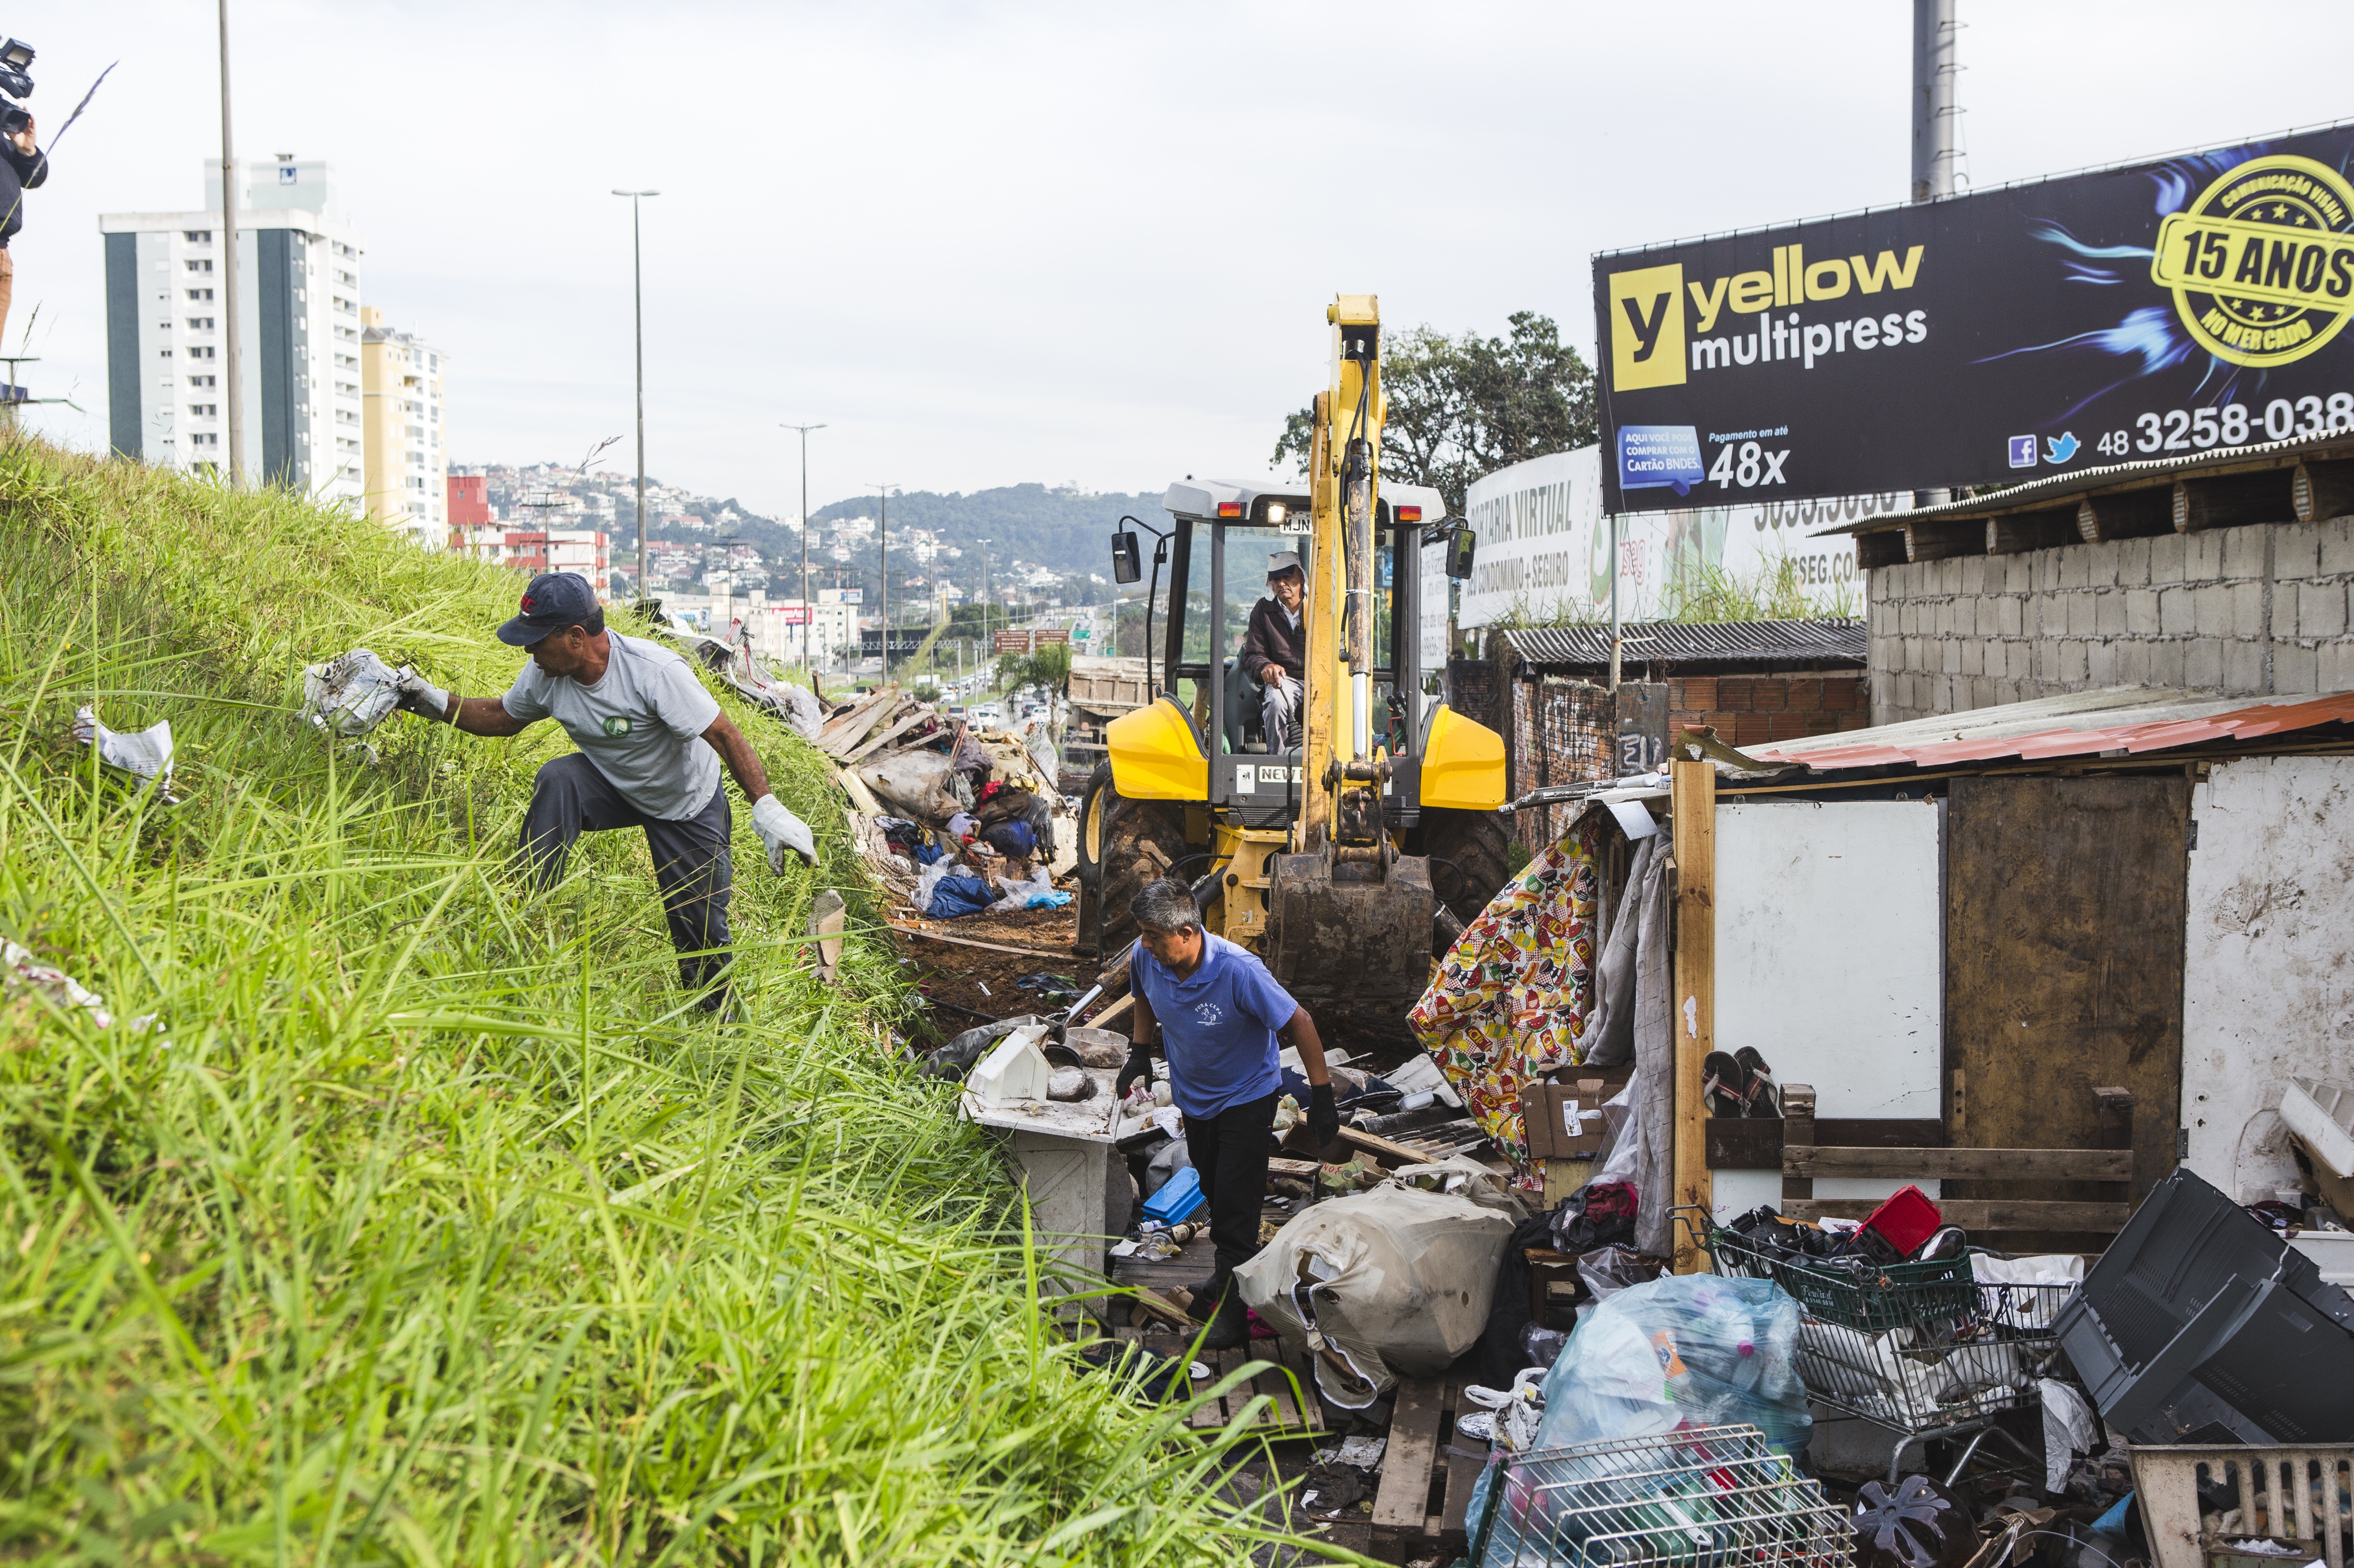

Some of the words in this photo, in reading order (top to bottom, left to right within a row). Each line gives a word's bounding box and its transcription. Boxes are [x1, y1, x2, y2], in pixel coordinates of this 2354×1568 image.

[2221, 174, 2313, 209] COMUNICAÇÃO
[2310, 185, 2346, 227] VISUAL
[2183, 230, 2231, 279] 15
[2234, 237, 2354, 298] ANOS
[1687, 243, 1924, 334] yellow
[1692, 310, 1927, 371] multipress
[2200, 307, 2229, 336] NO
[2222, 319, 2313, 351] MERCADO
[1625, 433, 1648, 445] AQUI
[1648, 431, 1670, 442] VOCÊ
[1672, 433, 1693, 442] PODE
[1626, 445, 1668, 456] COMPRAR
[1669, 445, 1688, 455] COM
[1708, 430, 1757, 444] Pagamento
[1759, 429, 1773, 438] em
[1774, 425, 1788, 436] até
[2097, 430, 2129, 456] 48
[1708, 441, 1791, 489] 48x
[1284, 518, 1310, 531] MJN
[1515, 480, 1572, 540] VIRTUAL
[1532, 551, 1569, 589] SEGURO
[1195, 1003, 1208, 1012] PURA
[1209, 1003, 1222, 1016] CEPA
